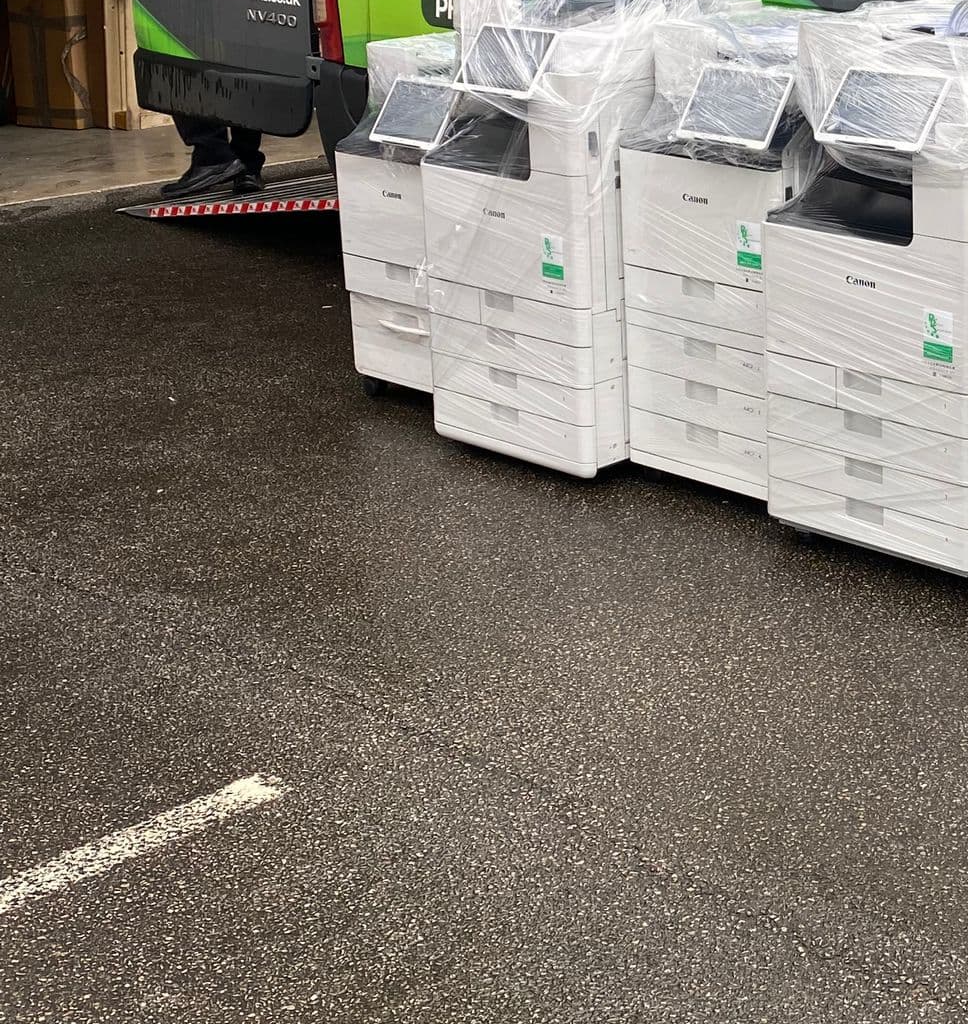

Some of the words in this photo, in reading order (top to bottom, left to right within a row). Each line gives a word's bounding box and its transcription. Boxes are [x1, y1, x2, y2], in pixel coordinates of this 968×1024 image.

[248, 8, 297, 28] NV400
[382, 189, 402, 200] Canon
[682, 193, 709, 205] Canon
[483, 207, 506, 219] Canon
[845, 275, 876, 289] Canon
